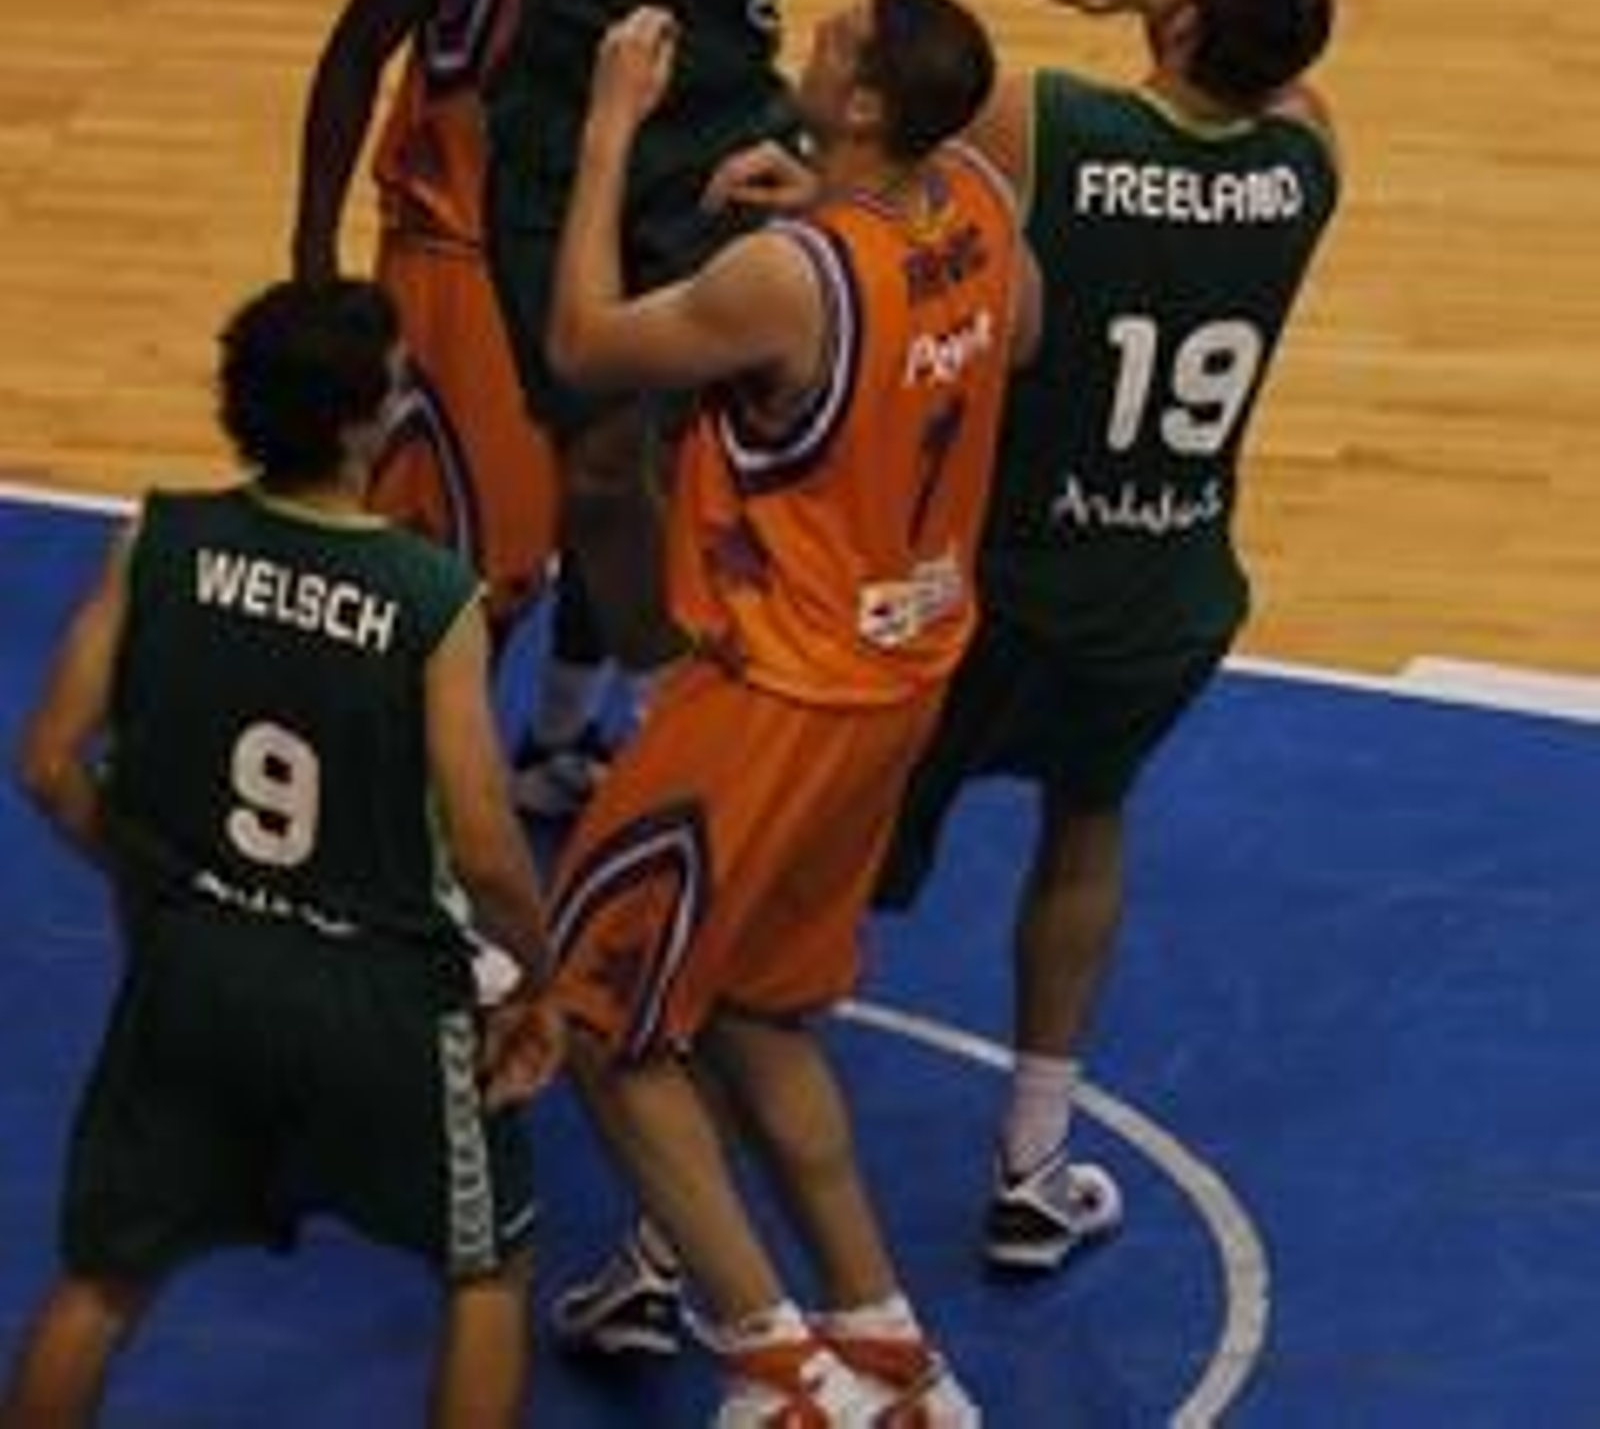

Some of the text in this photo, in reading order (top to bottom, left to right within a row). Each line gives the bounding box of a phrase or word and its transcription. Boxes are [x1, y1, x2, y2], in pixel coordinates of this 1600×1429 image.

[1075, 162, 1304, 223] FREELAND
[1106, 314, 1263, 454] 19
[196, 549, 397, 654] WELSCH
[226, 719, 321, 867] 9
